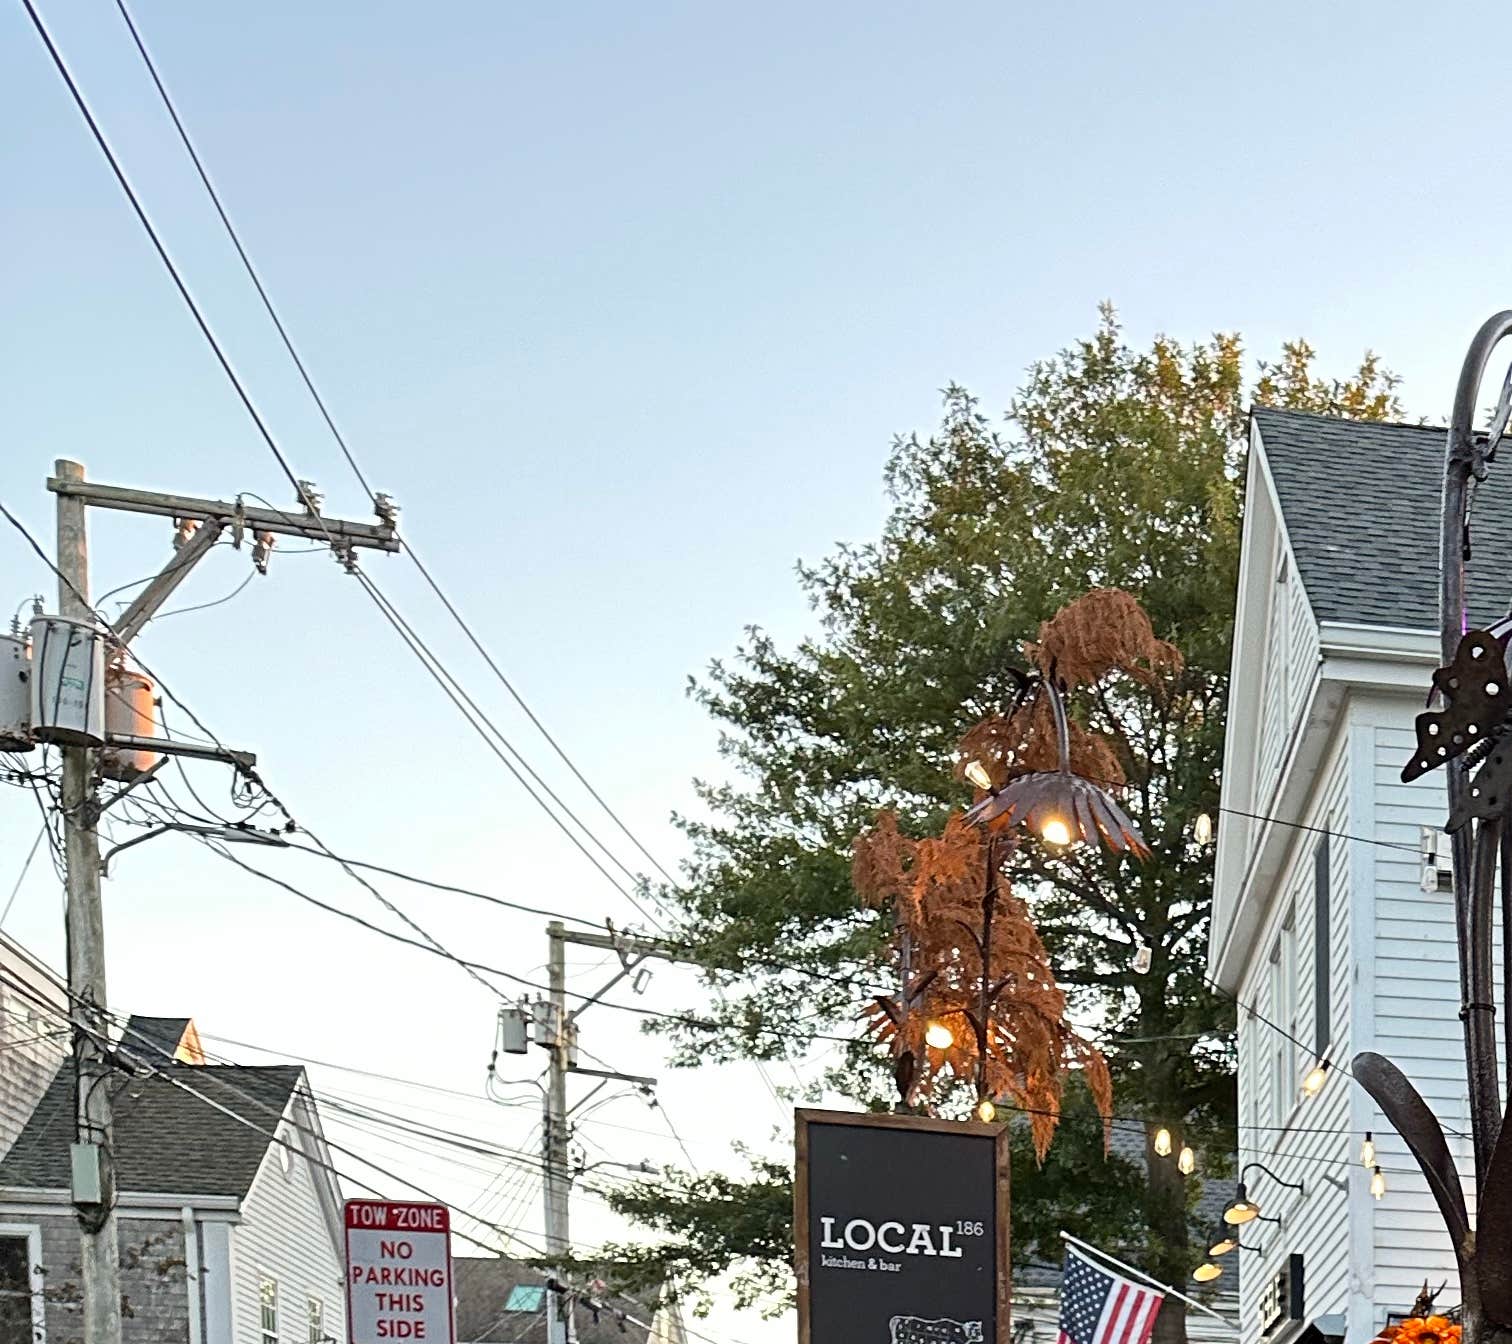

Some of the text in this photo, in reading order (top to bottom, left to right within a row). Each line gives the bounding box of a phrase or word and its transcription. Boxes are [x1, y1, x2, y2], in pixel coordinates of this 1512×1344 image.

[350, 1205, 443, 1229] TOW ZONE
[820, 1216, 984, 1258] LOCAL 186
[380, 1240, 413, 1259] NO
[821, 1254, 901, 1273] kitchen & bar
[352, 1266, 445, 1288] PARKING
[375, 1293, 424, 1313] THIS
[376, 1319, 425, 1339] SIDE
